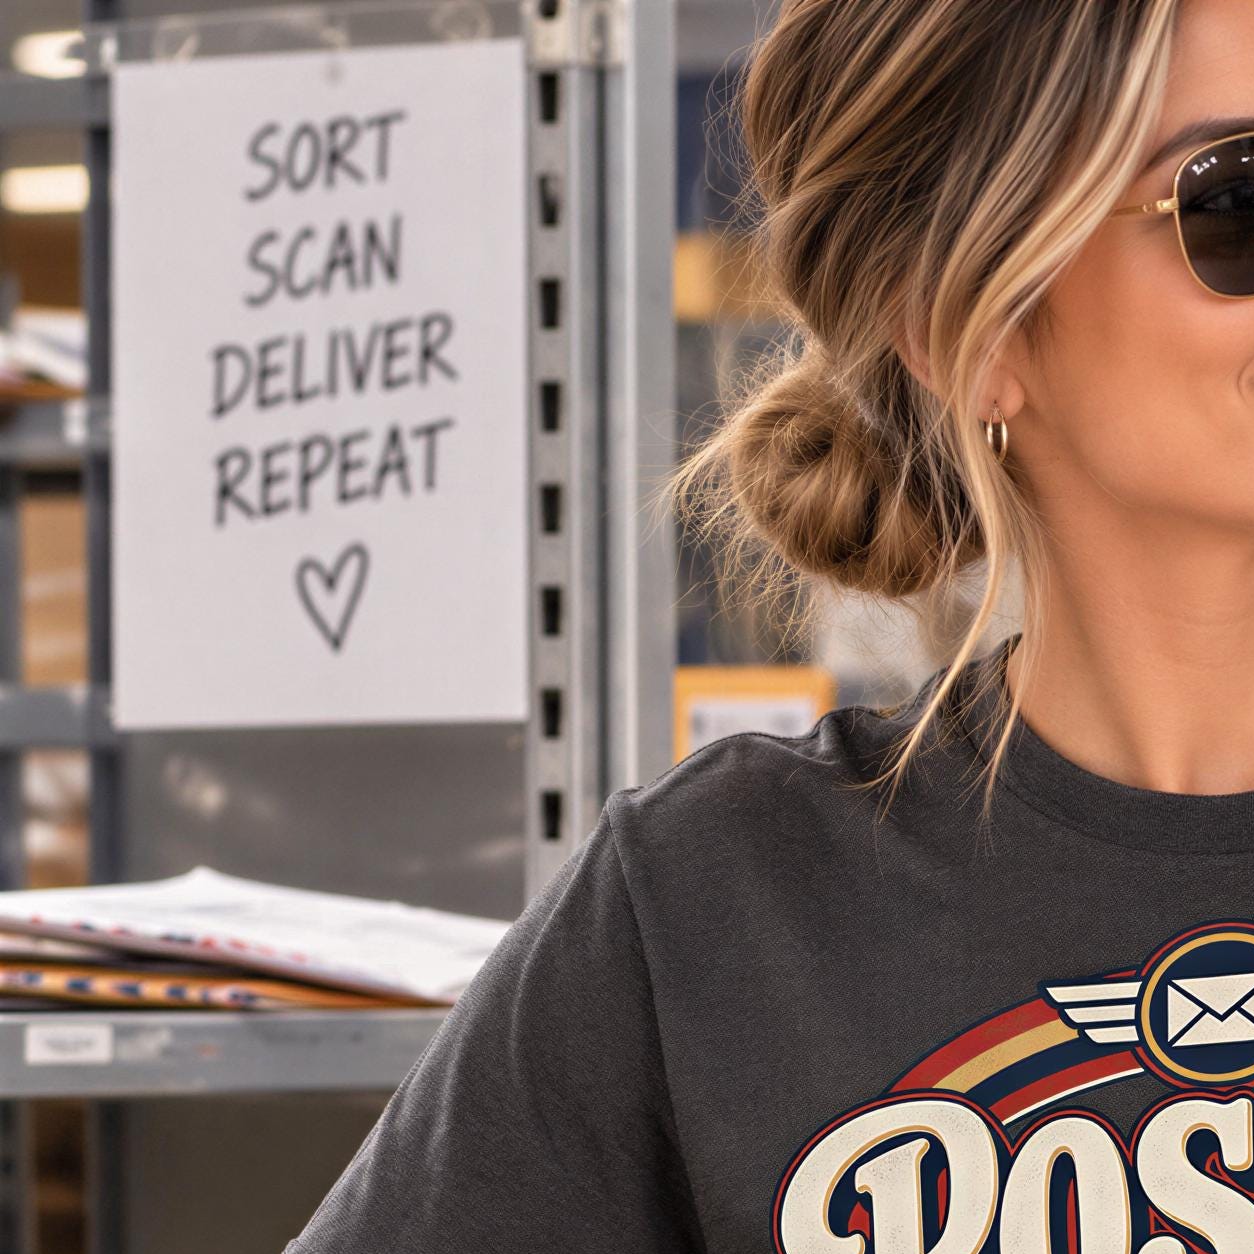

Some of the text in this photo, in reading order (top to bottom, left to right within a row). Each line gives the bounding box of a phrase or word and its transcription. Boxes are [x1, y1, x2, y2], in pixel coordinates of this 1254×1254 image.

[244, 110, 406, 203] SORT
[245, 212, 403, 308] SCAN
[210, 312, 458, 419] DELIVER
[213, 419, 455, 527] REPEAT
